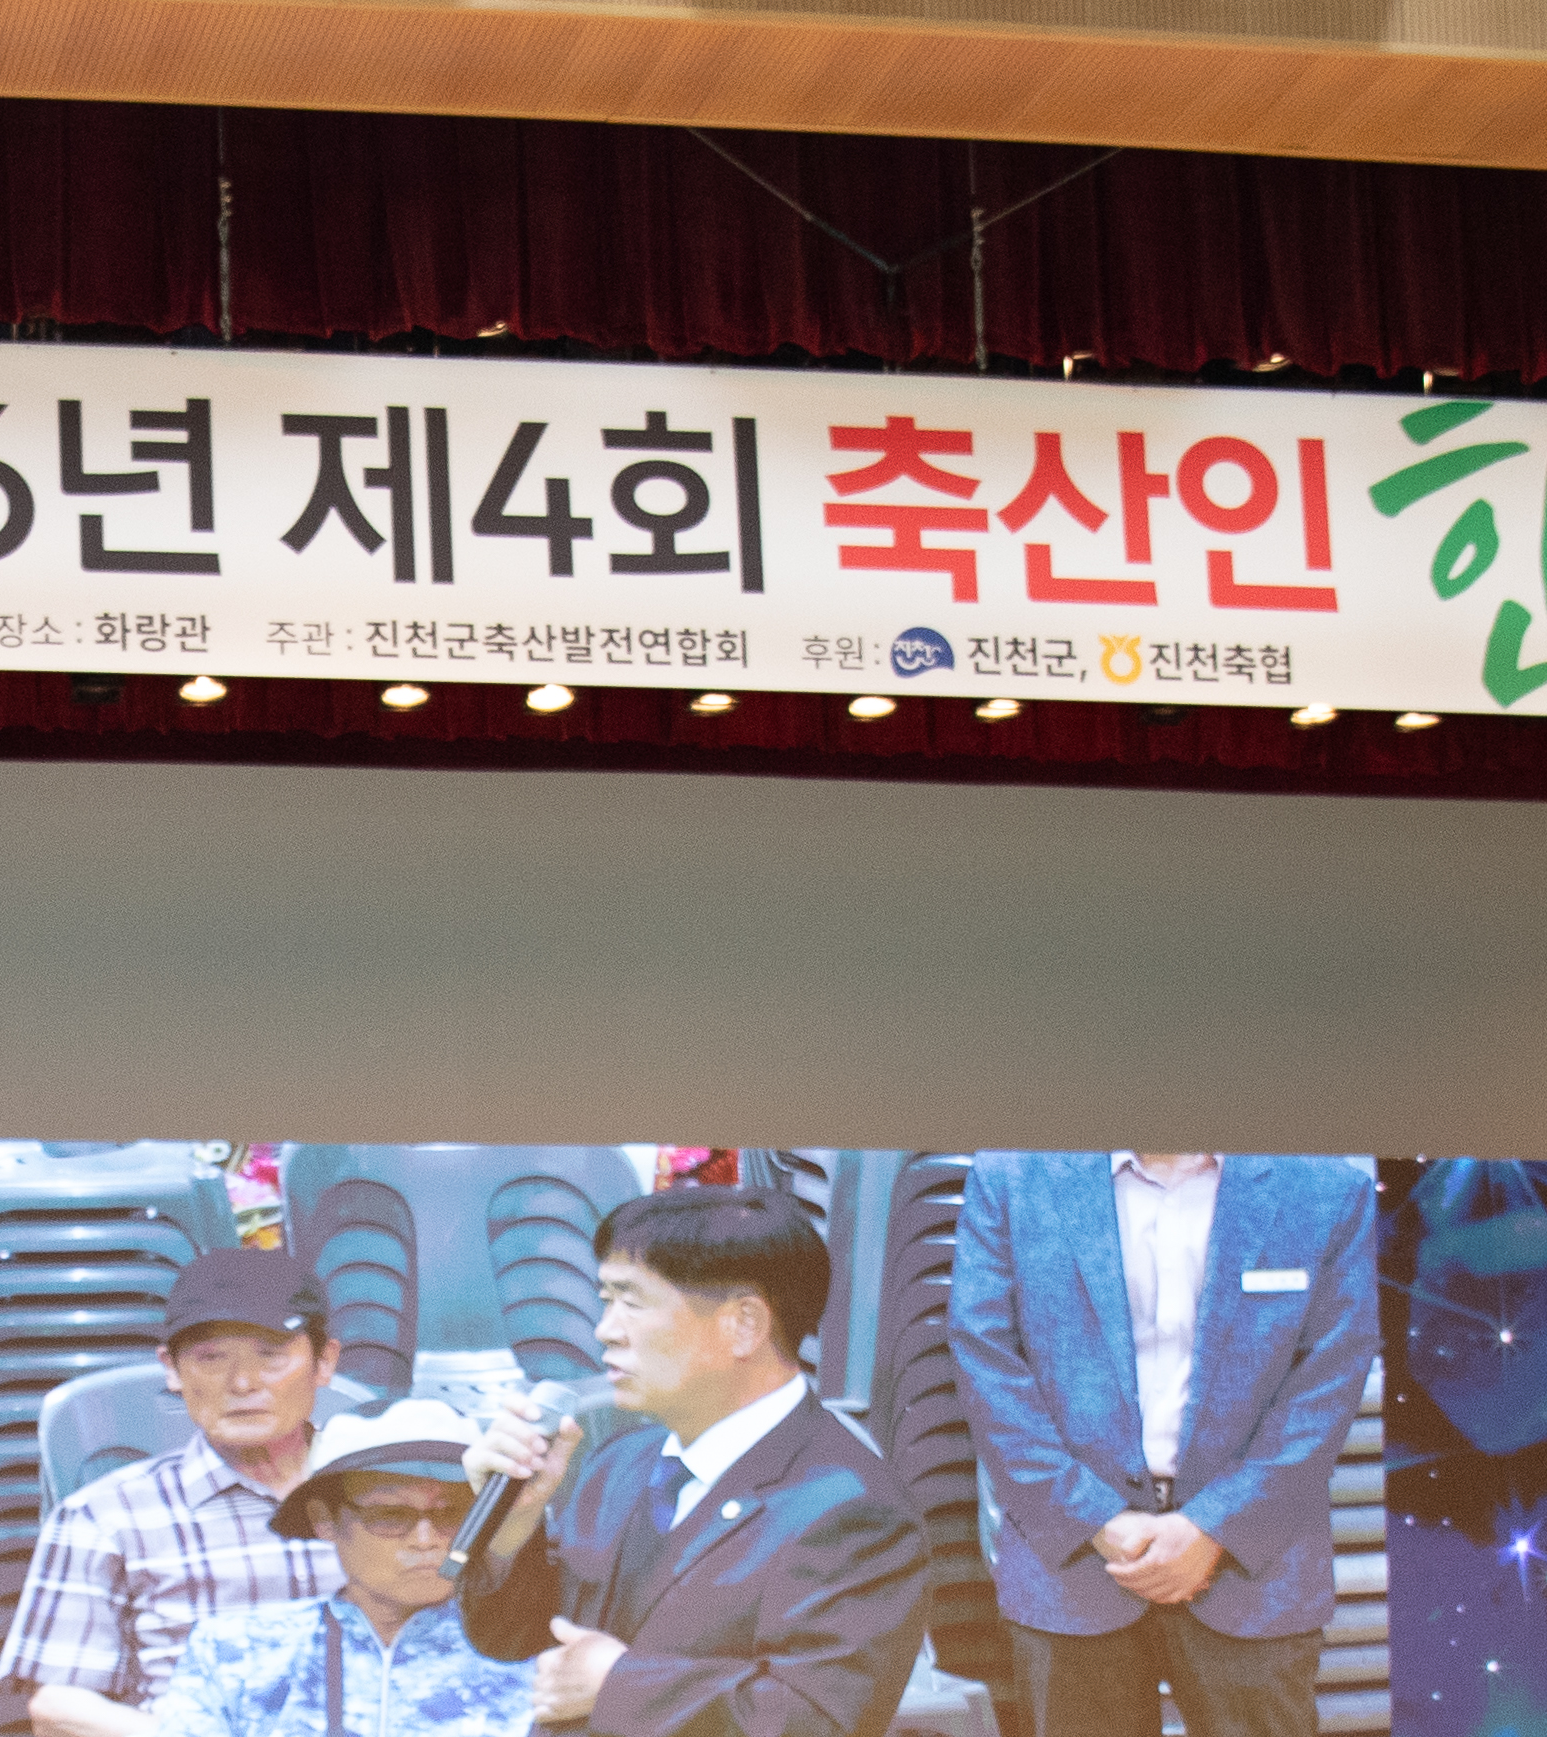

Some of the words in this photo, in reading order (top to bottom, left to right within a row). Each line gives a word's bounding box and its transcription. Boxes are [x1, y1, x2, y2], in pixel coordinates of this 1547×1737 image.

[279, 404, 766, 594] 제4회
[823, 413, 1340, 613] 축산인
[94, 612, 212, 654] 화랑관
[366, 620, 749, 669] 진천군축산발전연합회
[968, 636, 1088, 682] 진천군,
[1150, 642, 1293, 686] 진천축협
